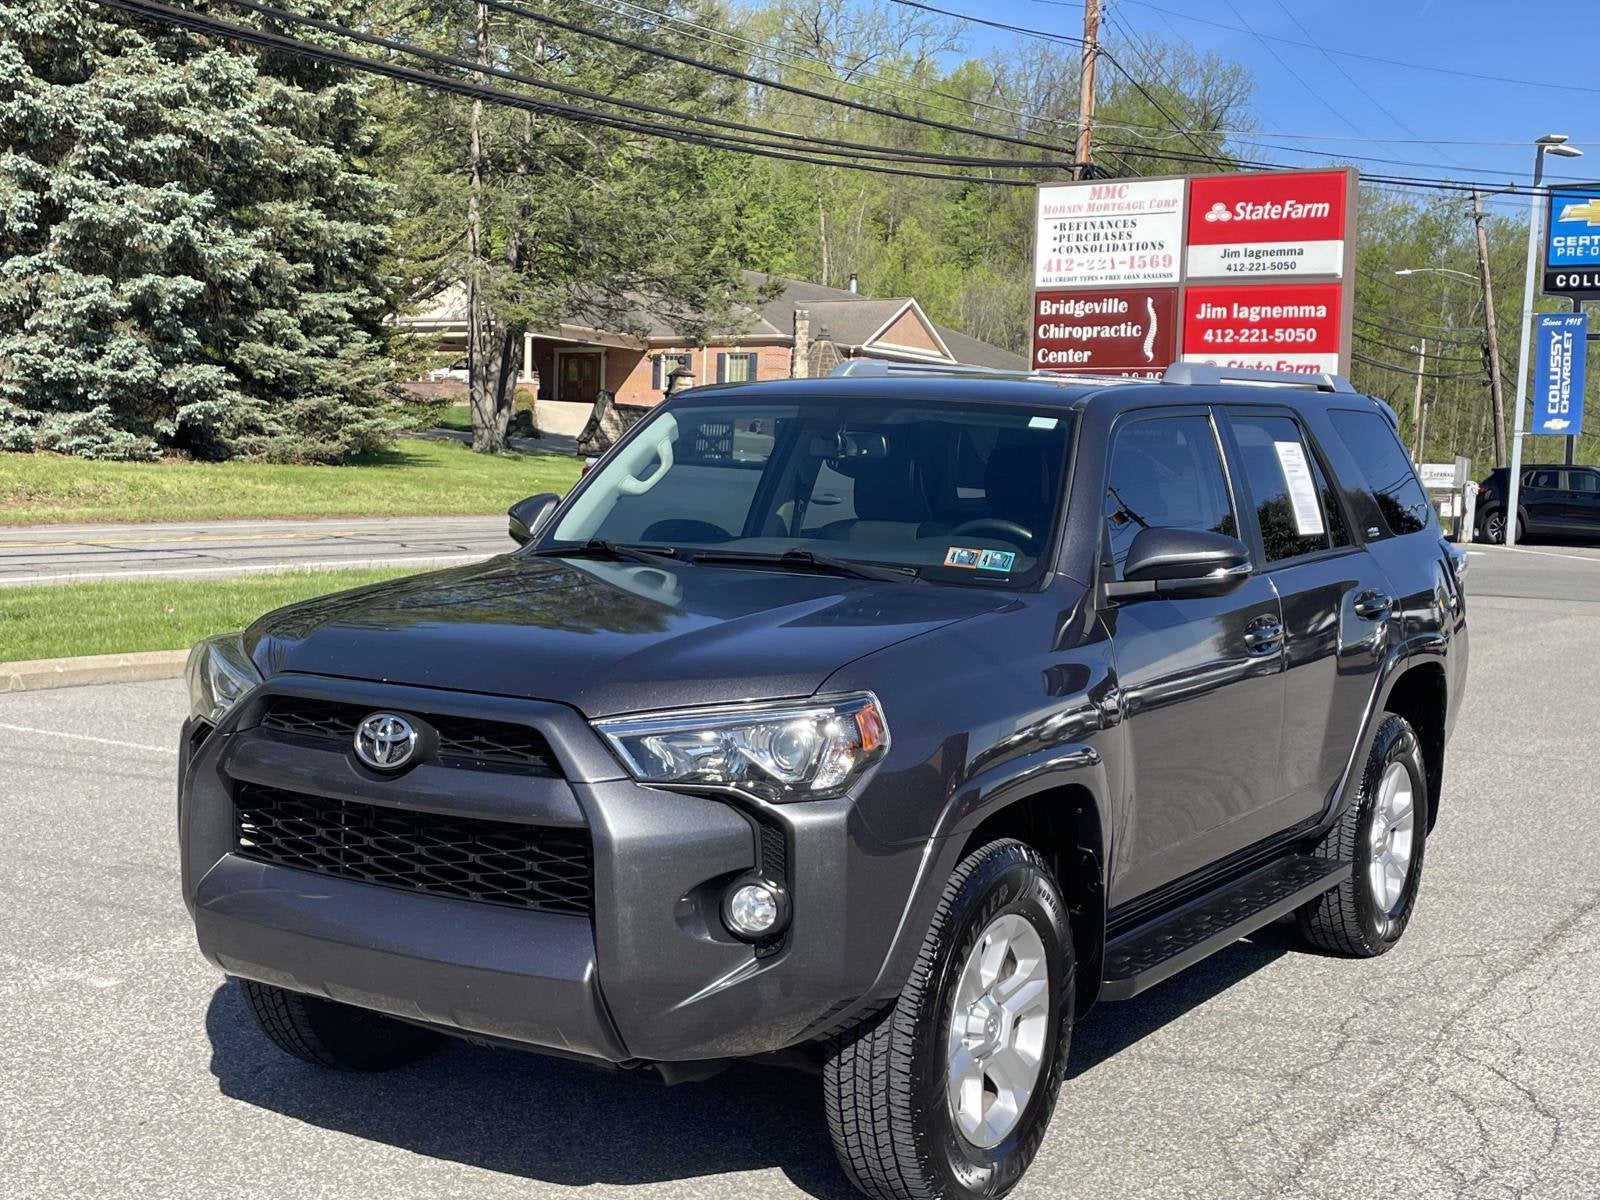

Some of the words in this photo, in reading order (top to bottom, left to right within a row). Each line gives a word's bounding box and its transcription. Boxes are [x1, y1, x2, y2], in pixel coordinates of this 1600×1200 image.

[1088, 185, 1129, 200] MMC
[1233, 199, 1330, 221] StateFarm
[1059, 219, 1137, 231] REFINANCES
[1058, 231, 1133, 243] PURCHASES
[1058, 240, 1165, 255] CONSOLIDATIONS
[1220, 249, 1241, 259] Jim
[1243, 247, 1304, 259] Iagnemma
[1043, 254, 1173, 273] 412-221-1569
[1226, 261, 1297, 272] 412-221-5050
[1040, 298, 1128, 317] Bridgeville
[1196, 303, 1227, 319] Jim
[1232, 303, 1327, 321] Iagnemma
[1542, 318, 1562, 326] Since
[1565, 317, 1583, 326] 1918
[1038, 322, 1142, 341] Chiropractic
[1203, 328, 1317, 343] 412-221-5050
[1037, 348, 1092, 363] Center
[1547, 330, 1563, 414] COLUSSY
[1560, 330, 1573, 414] CHEVROLET
